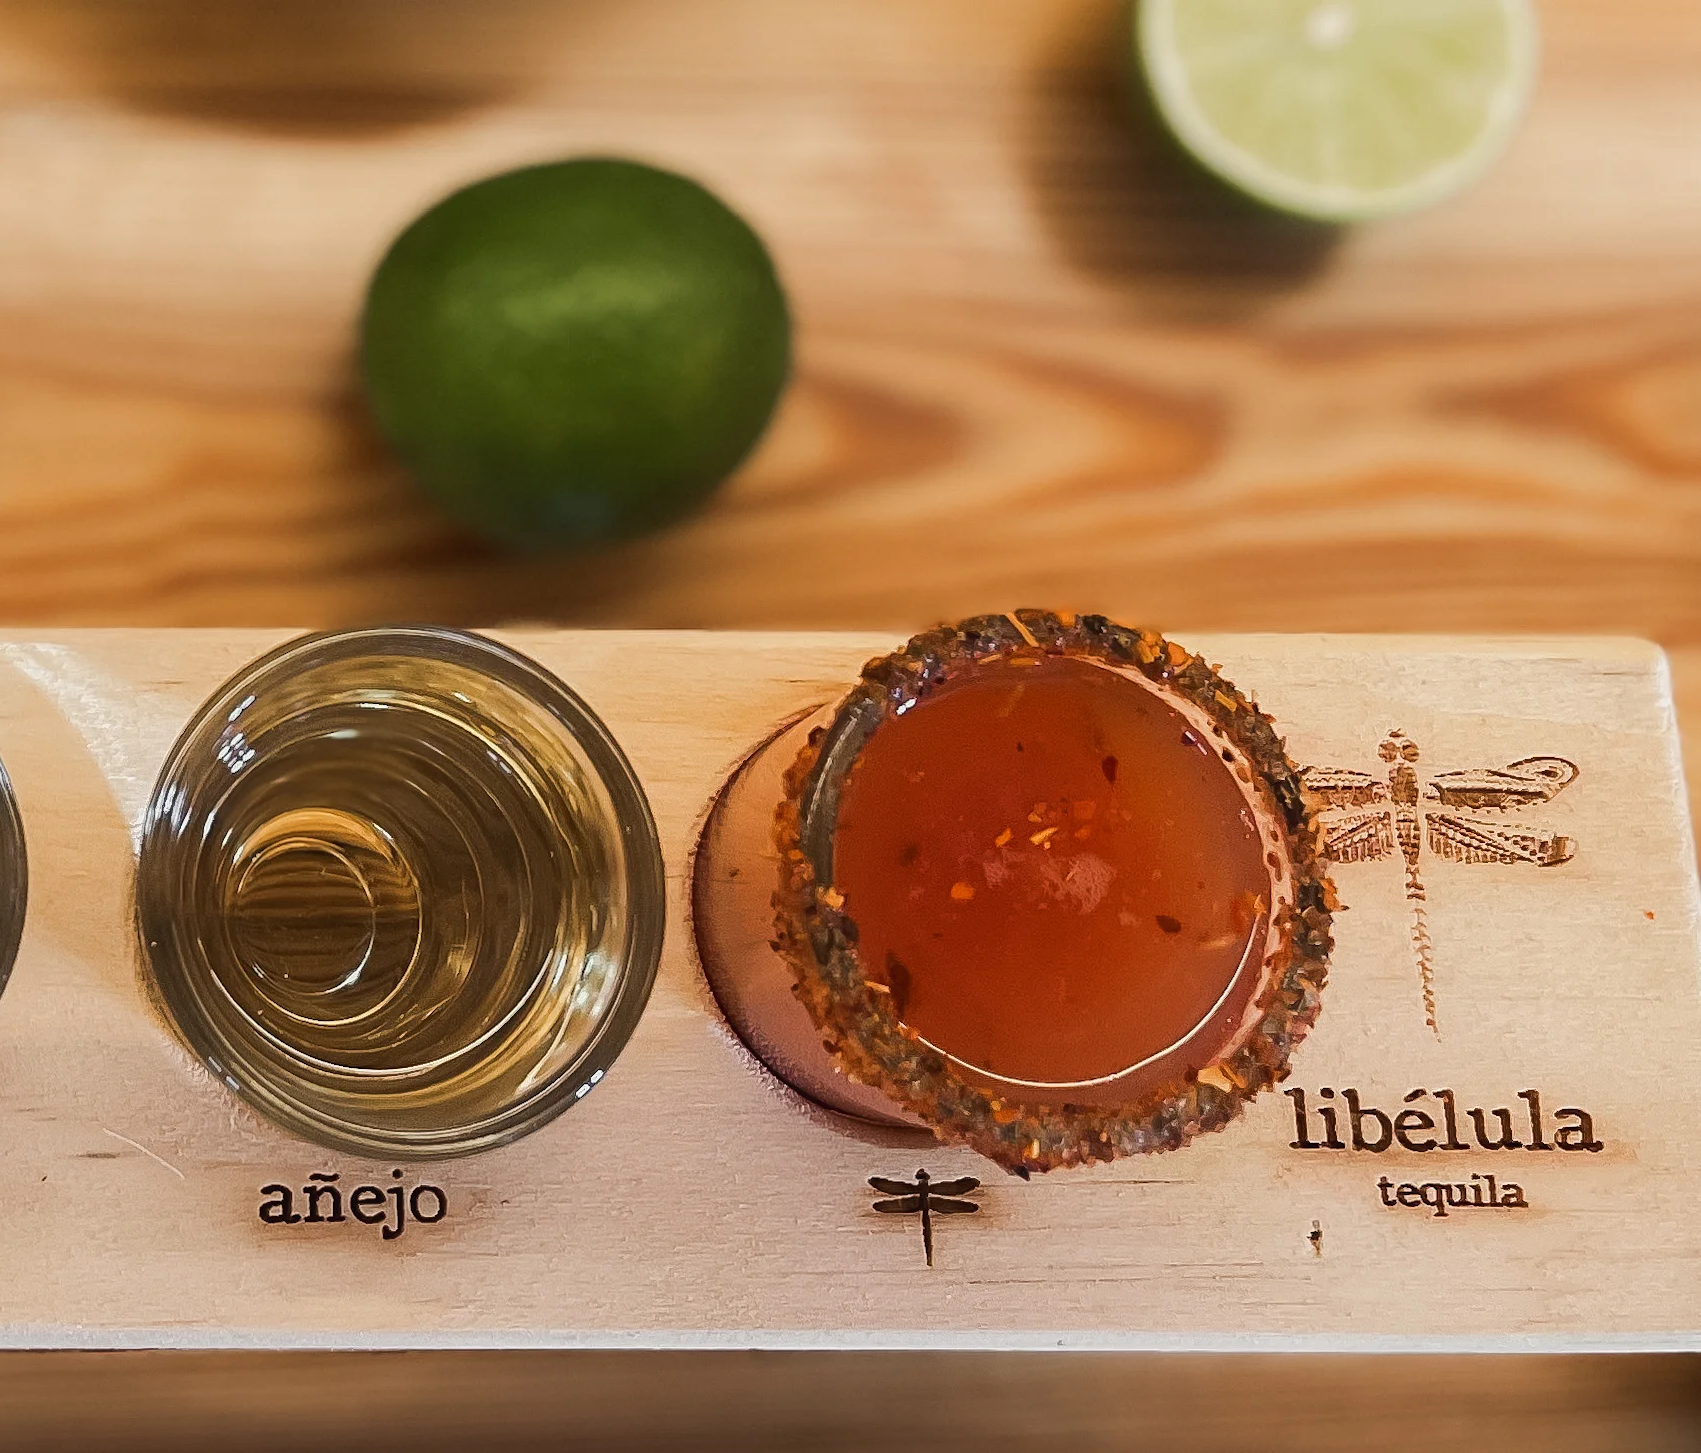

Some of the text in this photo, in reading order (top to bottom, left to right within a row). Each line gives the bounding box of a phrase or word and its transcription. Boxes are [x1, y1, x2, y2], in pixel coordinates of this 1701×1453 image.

[1287, 1087, 1604, 1153] libélula
[258, 1169, 448, 1240] añejo
[1377, 1173, 1529, 1218] tequila
